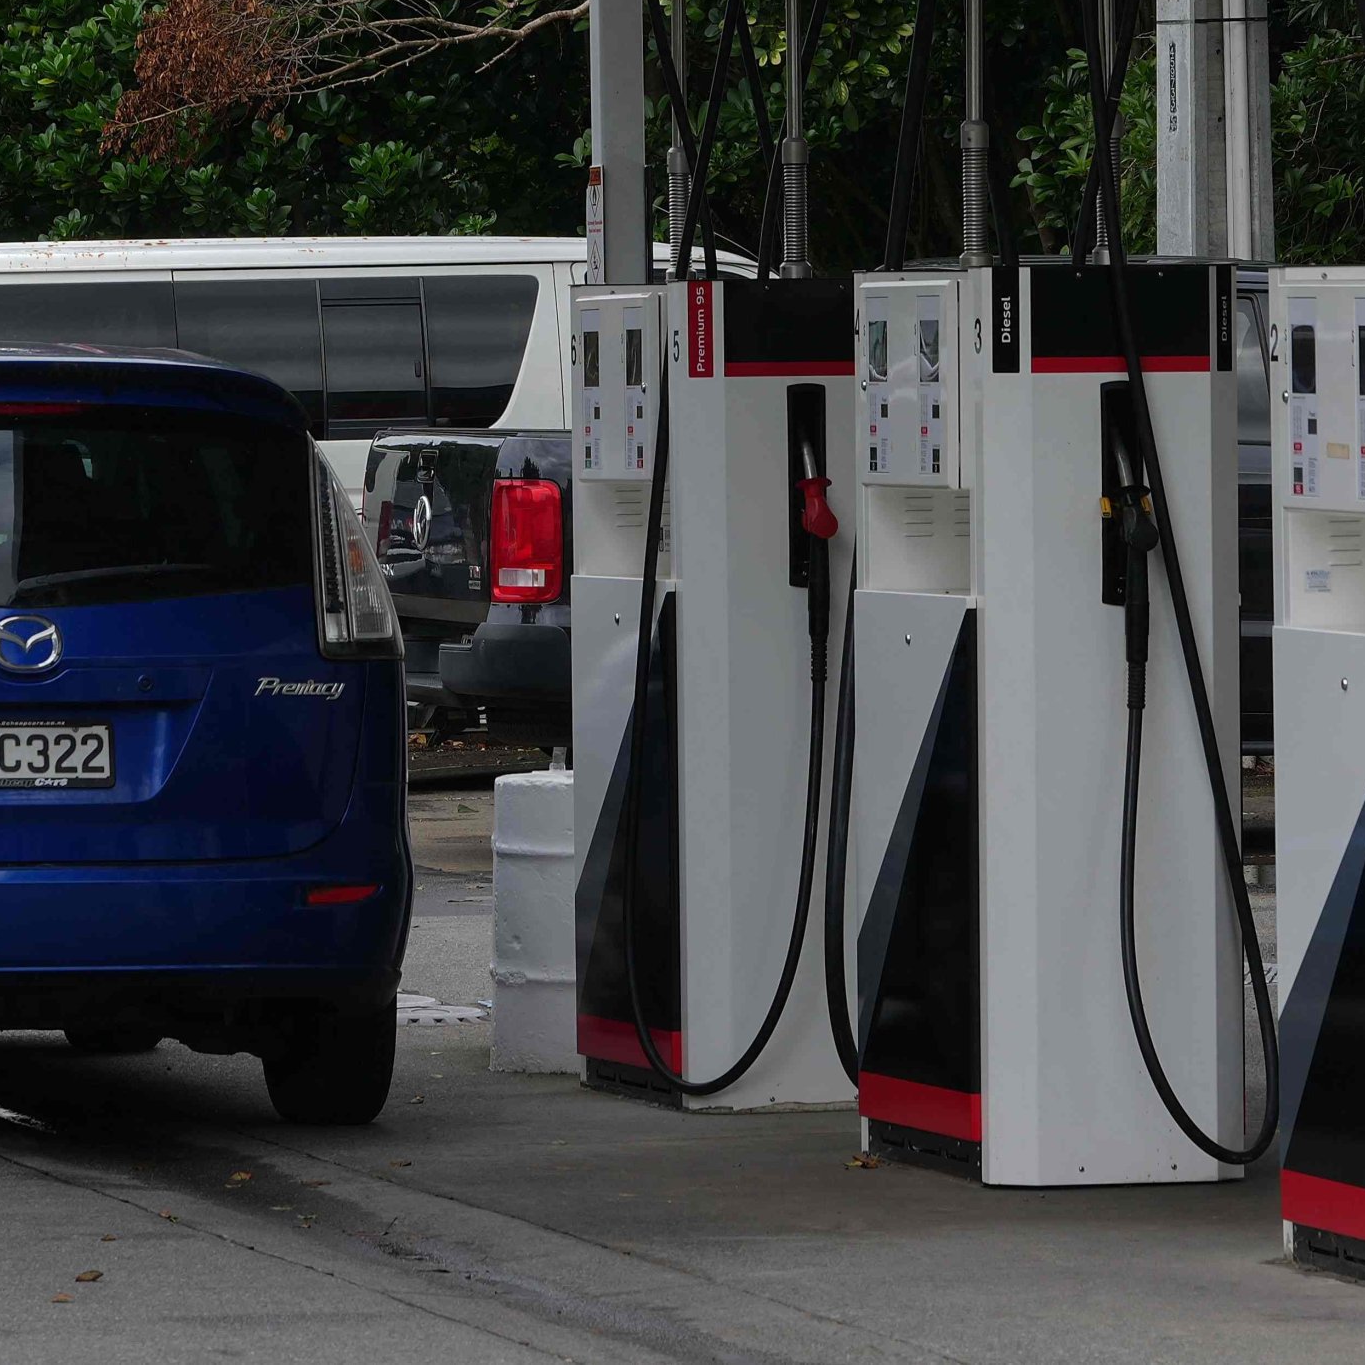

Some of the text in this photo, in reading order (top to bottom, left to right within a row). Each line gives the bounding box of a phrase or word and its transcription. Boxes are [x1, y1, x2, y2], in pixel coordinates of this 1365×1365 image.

[696, 286, 705, 371] Premium 95
[974, 318, 982, 354] 3
[1001, 296, 1011, 343] Diesel
[570, 334, 577, 366] 6
[673, 330, 680, 362] 5
[1271, 323, 1278, 362] 2
[254, 677, 345, 700] Premacy
